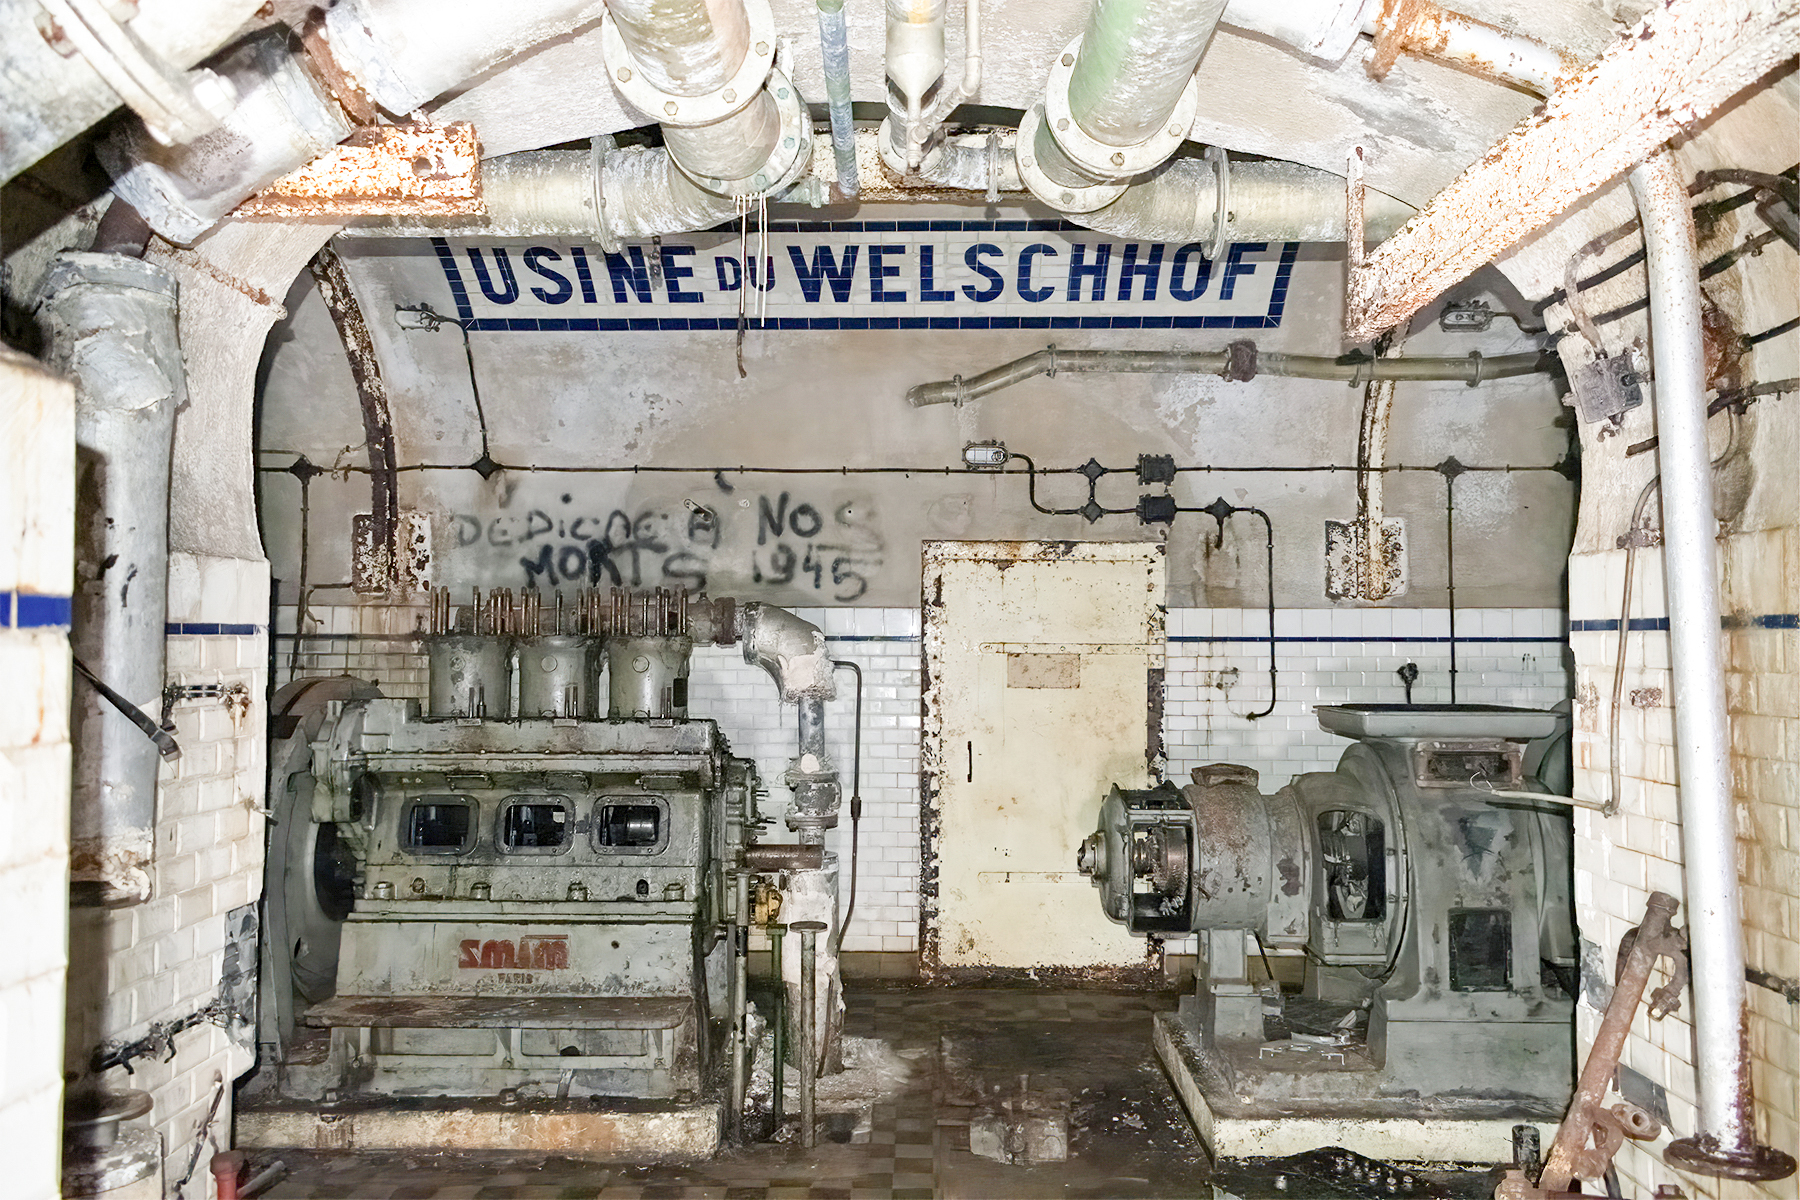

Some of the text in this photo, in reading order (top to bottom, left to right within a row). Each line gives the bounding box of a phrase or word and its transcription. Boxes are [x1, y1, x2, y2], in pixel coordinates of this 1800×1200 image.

[467, 242, 1268, 305] USINE DU WELSCHHOF
[519, 540, 708, 595] MORTS
